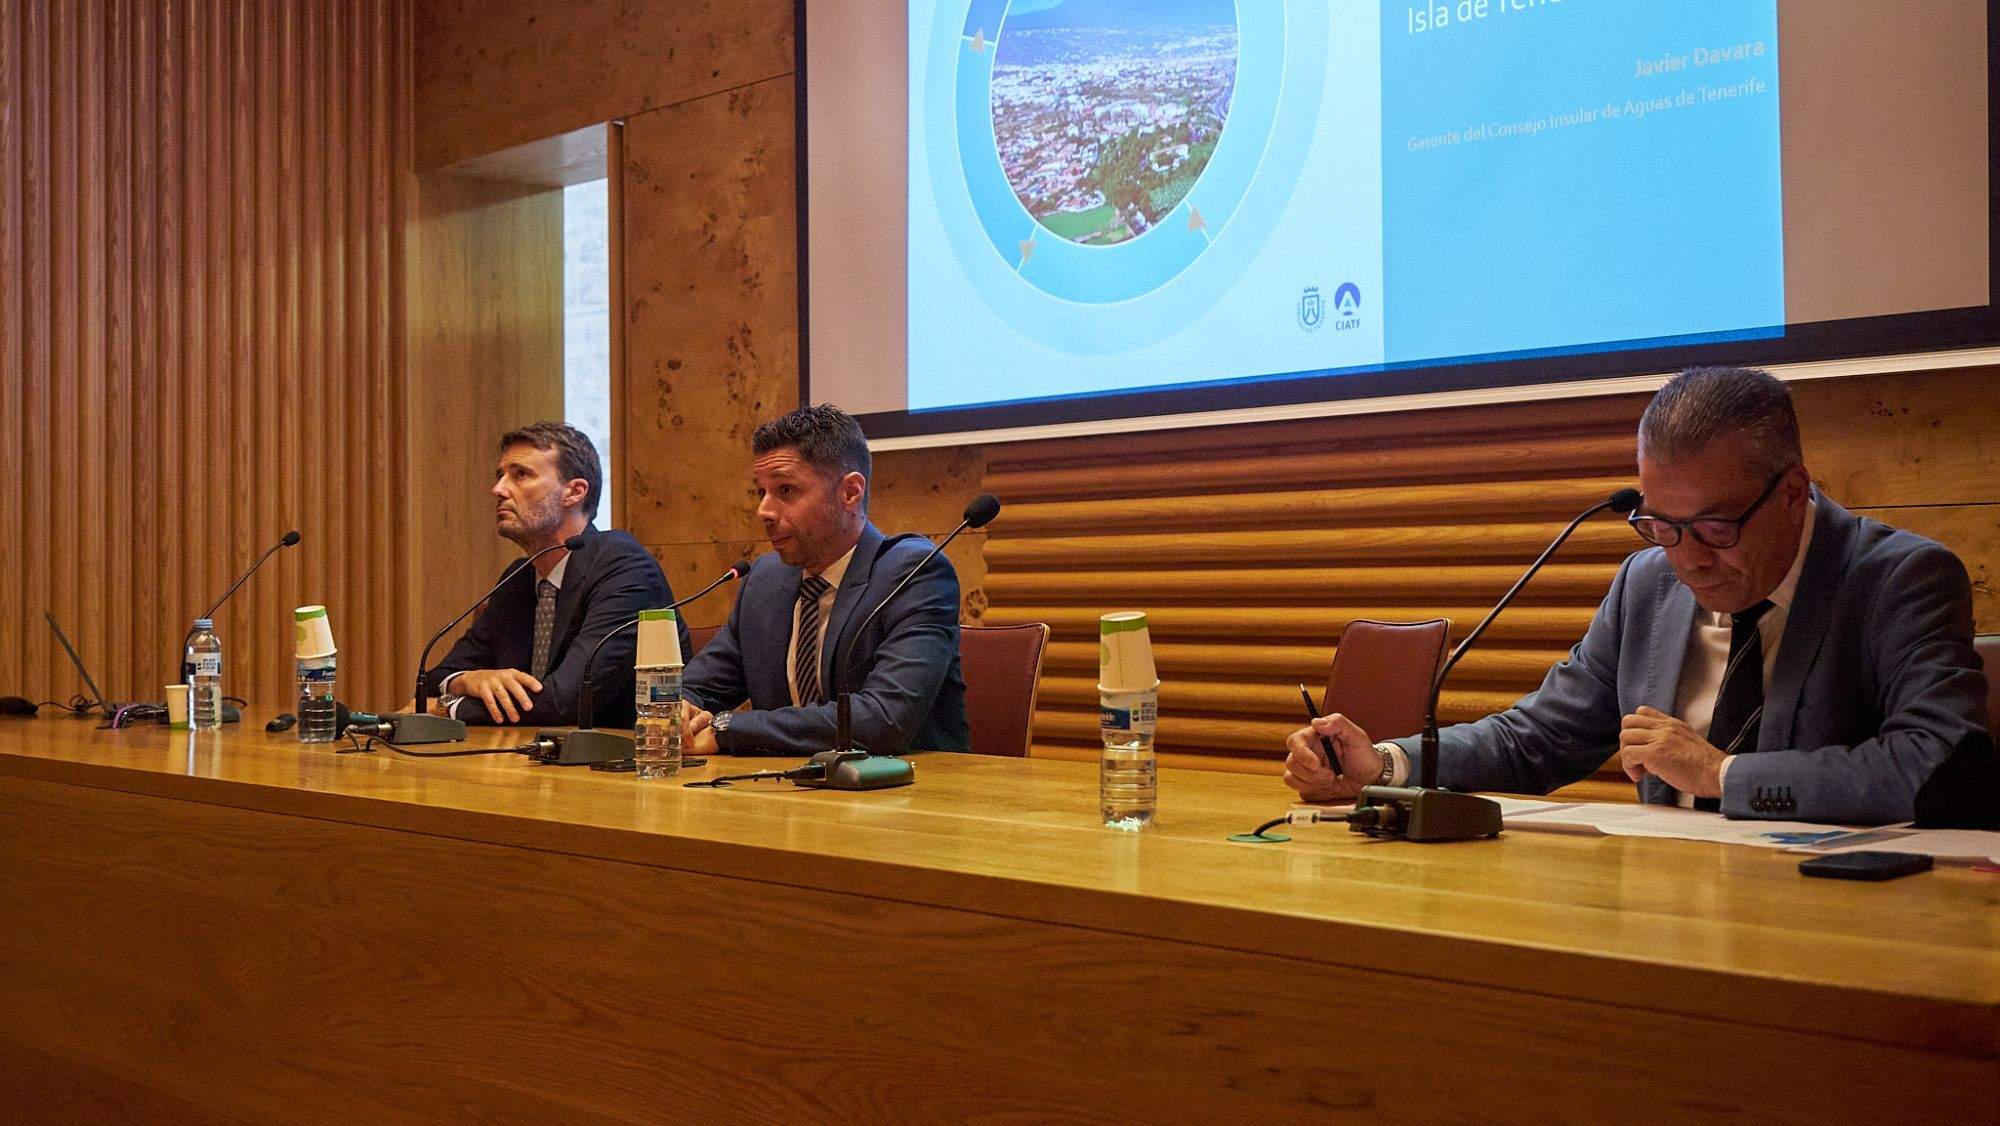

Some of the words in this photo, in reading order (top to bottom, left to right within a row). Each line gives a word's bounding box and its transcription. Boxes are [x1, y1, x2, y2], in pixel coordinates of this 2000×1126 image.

[1408, 0, 1449, 34] Isla
[1457, 0, 1488, 22] de
[1633, 53, 1690, 79] Javier
[1693, 40, 1766, 68] Davara
[1407, 131, 1460, 151] Gerente
[1464, 124, 1485, 142] del
[1488, 117, 1546, 137] Consejo
[1550, 105, 1598, 129] Insular
[1602, 103, 1620, 119] de
[1624, 97, 1672, 118] Aguas
[1675, 90, 1696, 107] de
[1700, 77, 1766, 102] Tenerife
[1335, 319, 1361, 331] CIATF
